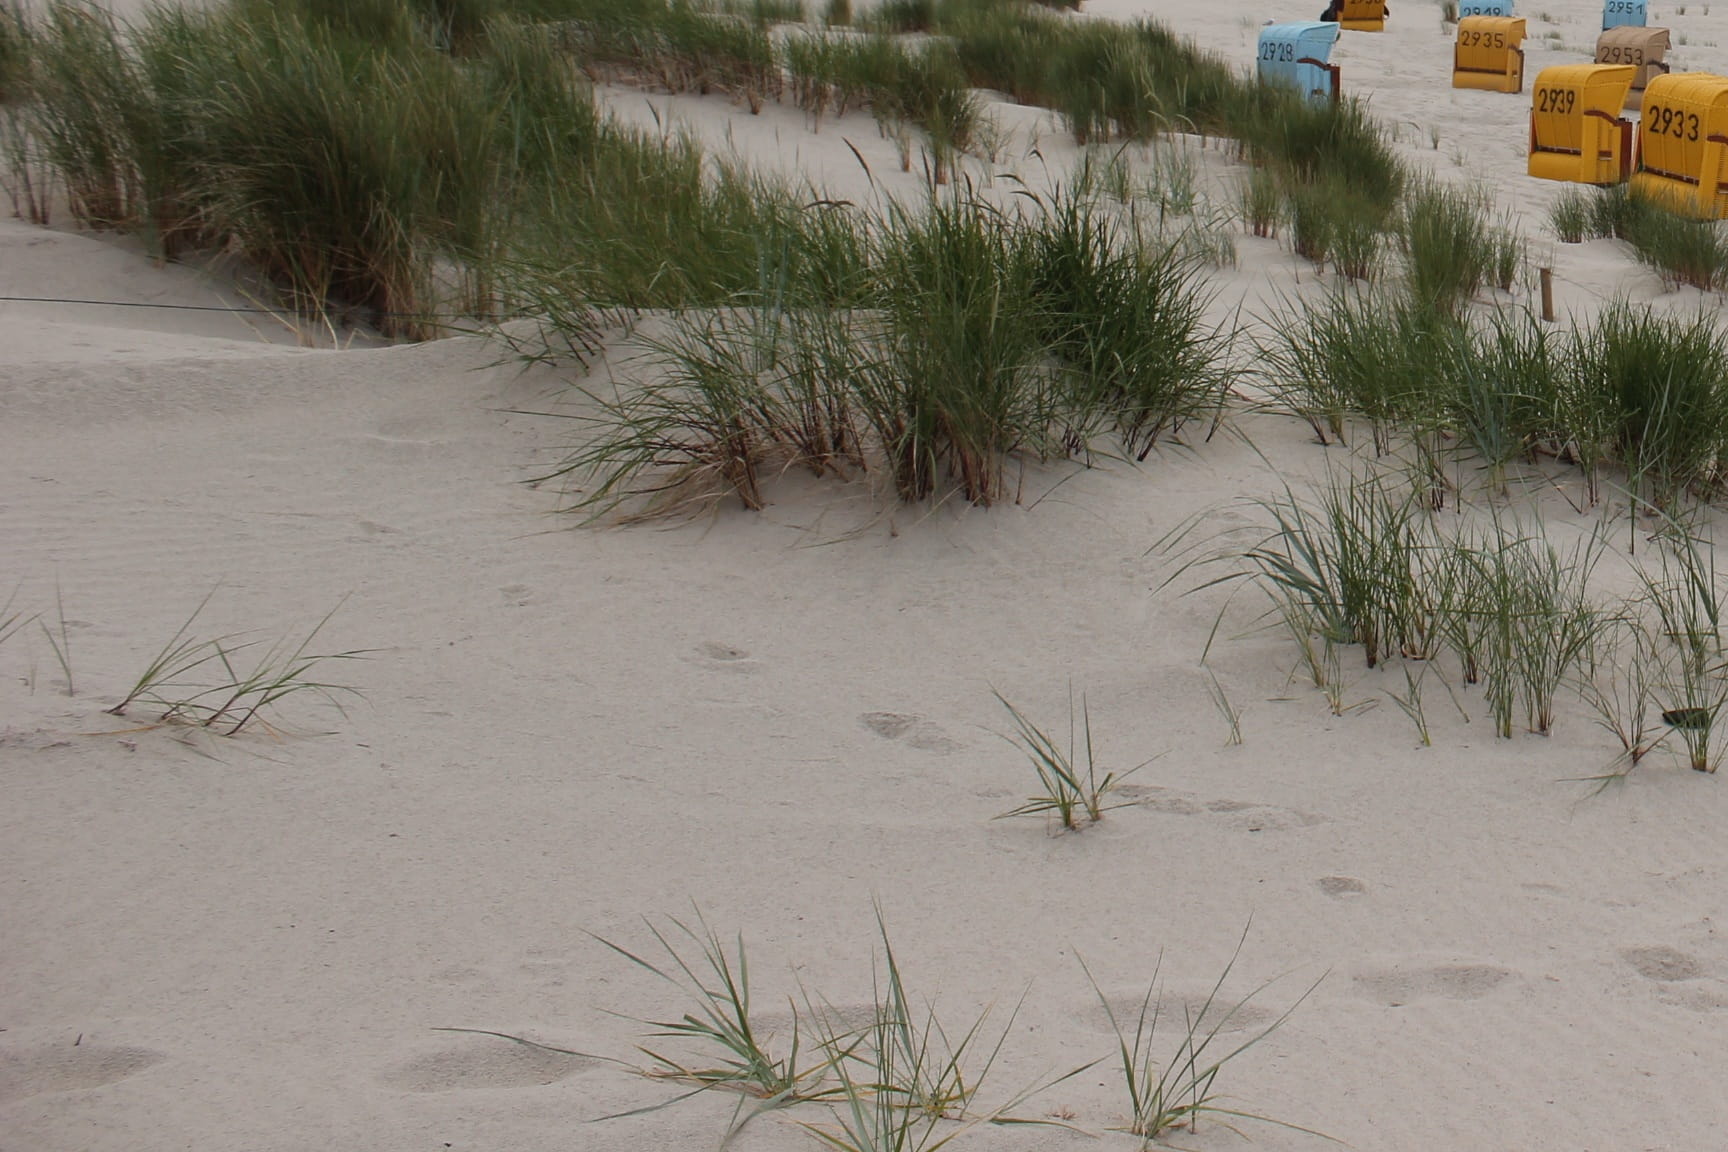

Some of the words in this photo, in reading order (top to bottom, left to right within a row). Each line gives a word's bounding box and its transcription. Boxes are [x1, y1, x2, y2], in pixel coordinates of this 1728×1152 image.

[1608, 1, 1644, 15] 2951
[1461, 31, 1504, 48] 2935
[1261, 41, 1292, 62] 2928
[1601, 46, 1643, 65] 2953
[1538, 88, 1575, 113] 2939
[1648, 106, 1700, 141] 2933
